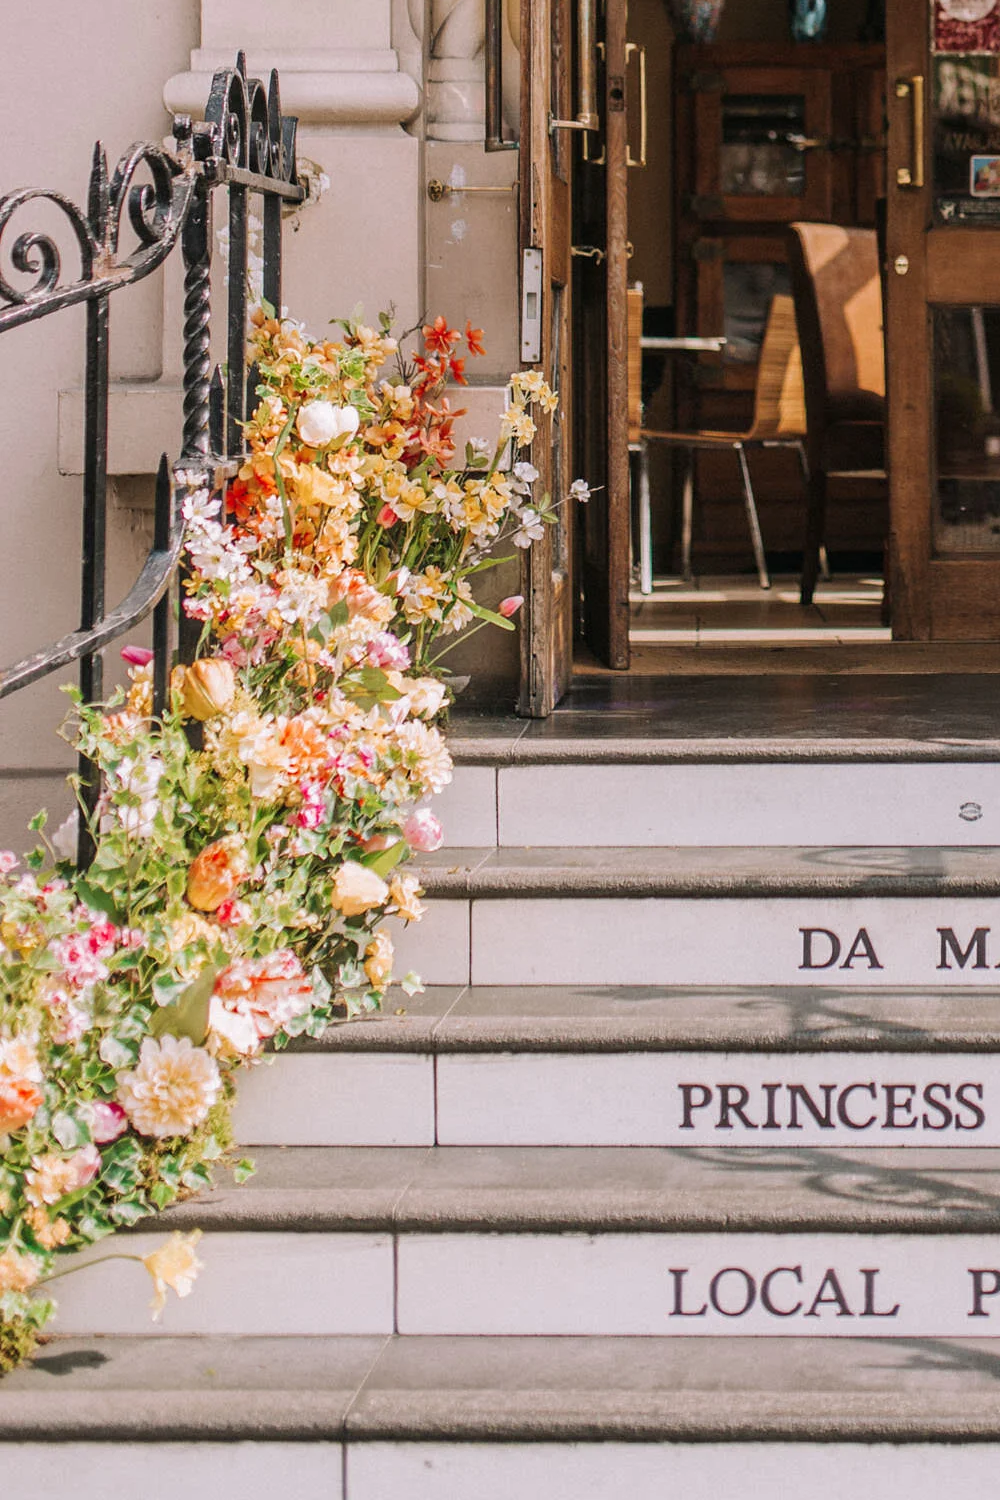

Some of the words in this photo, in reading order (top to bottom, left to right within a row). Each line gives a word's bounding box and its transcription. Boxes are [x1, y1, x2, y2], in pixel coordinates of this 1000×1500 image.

[797, 927, 884, 971] DA
[677, 1082, 986, 1131] PRINCESS
[667, 1264, 901, 1318] LOCAL
